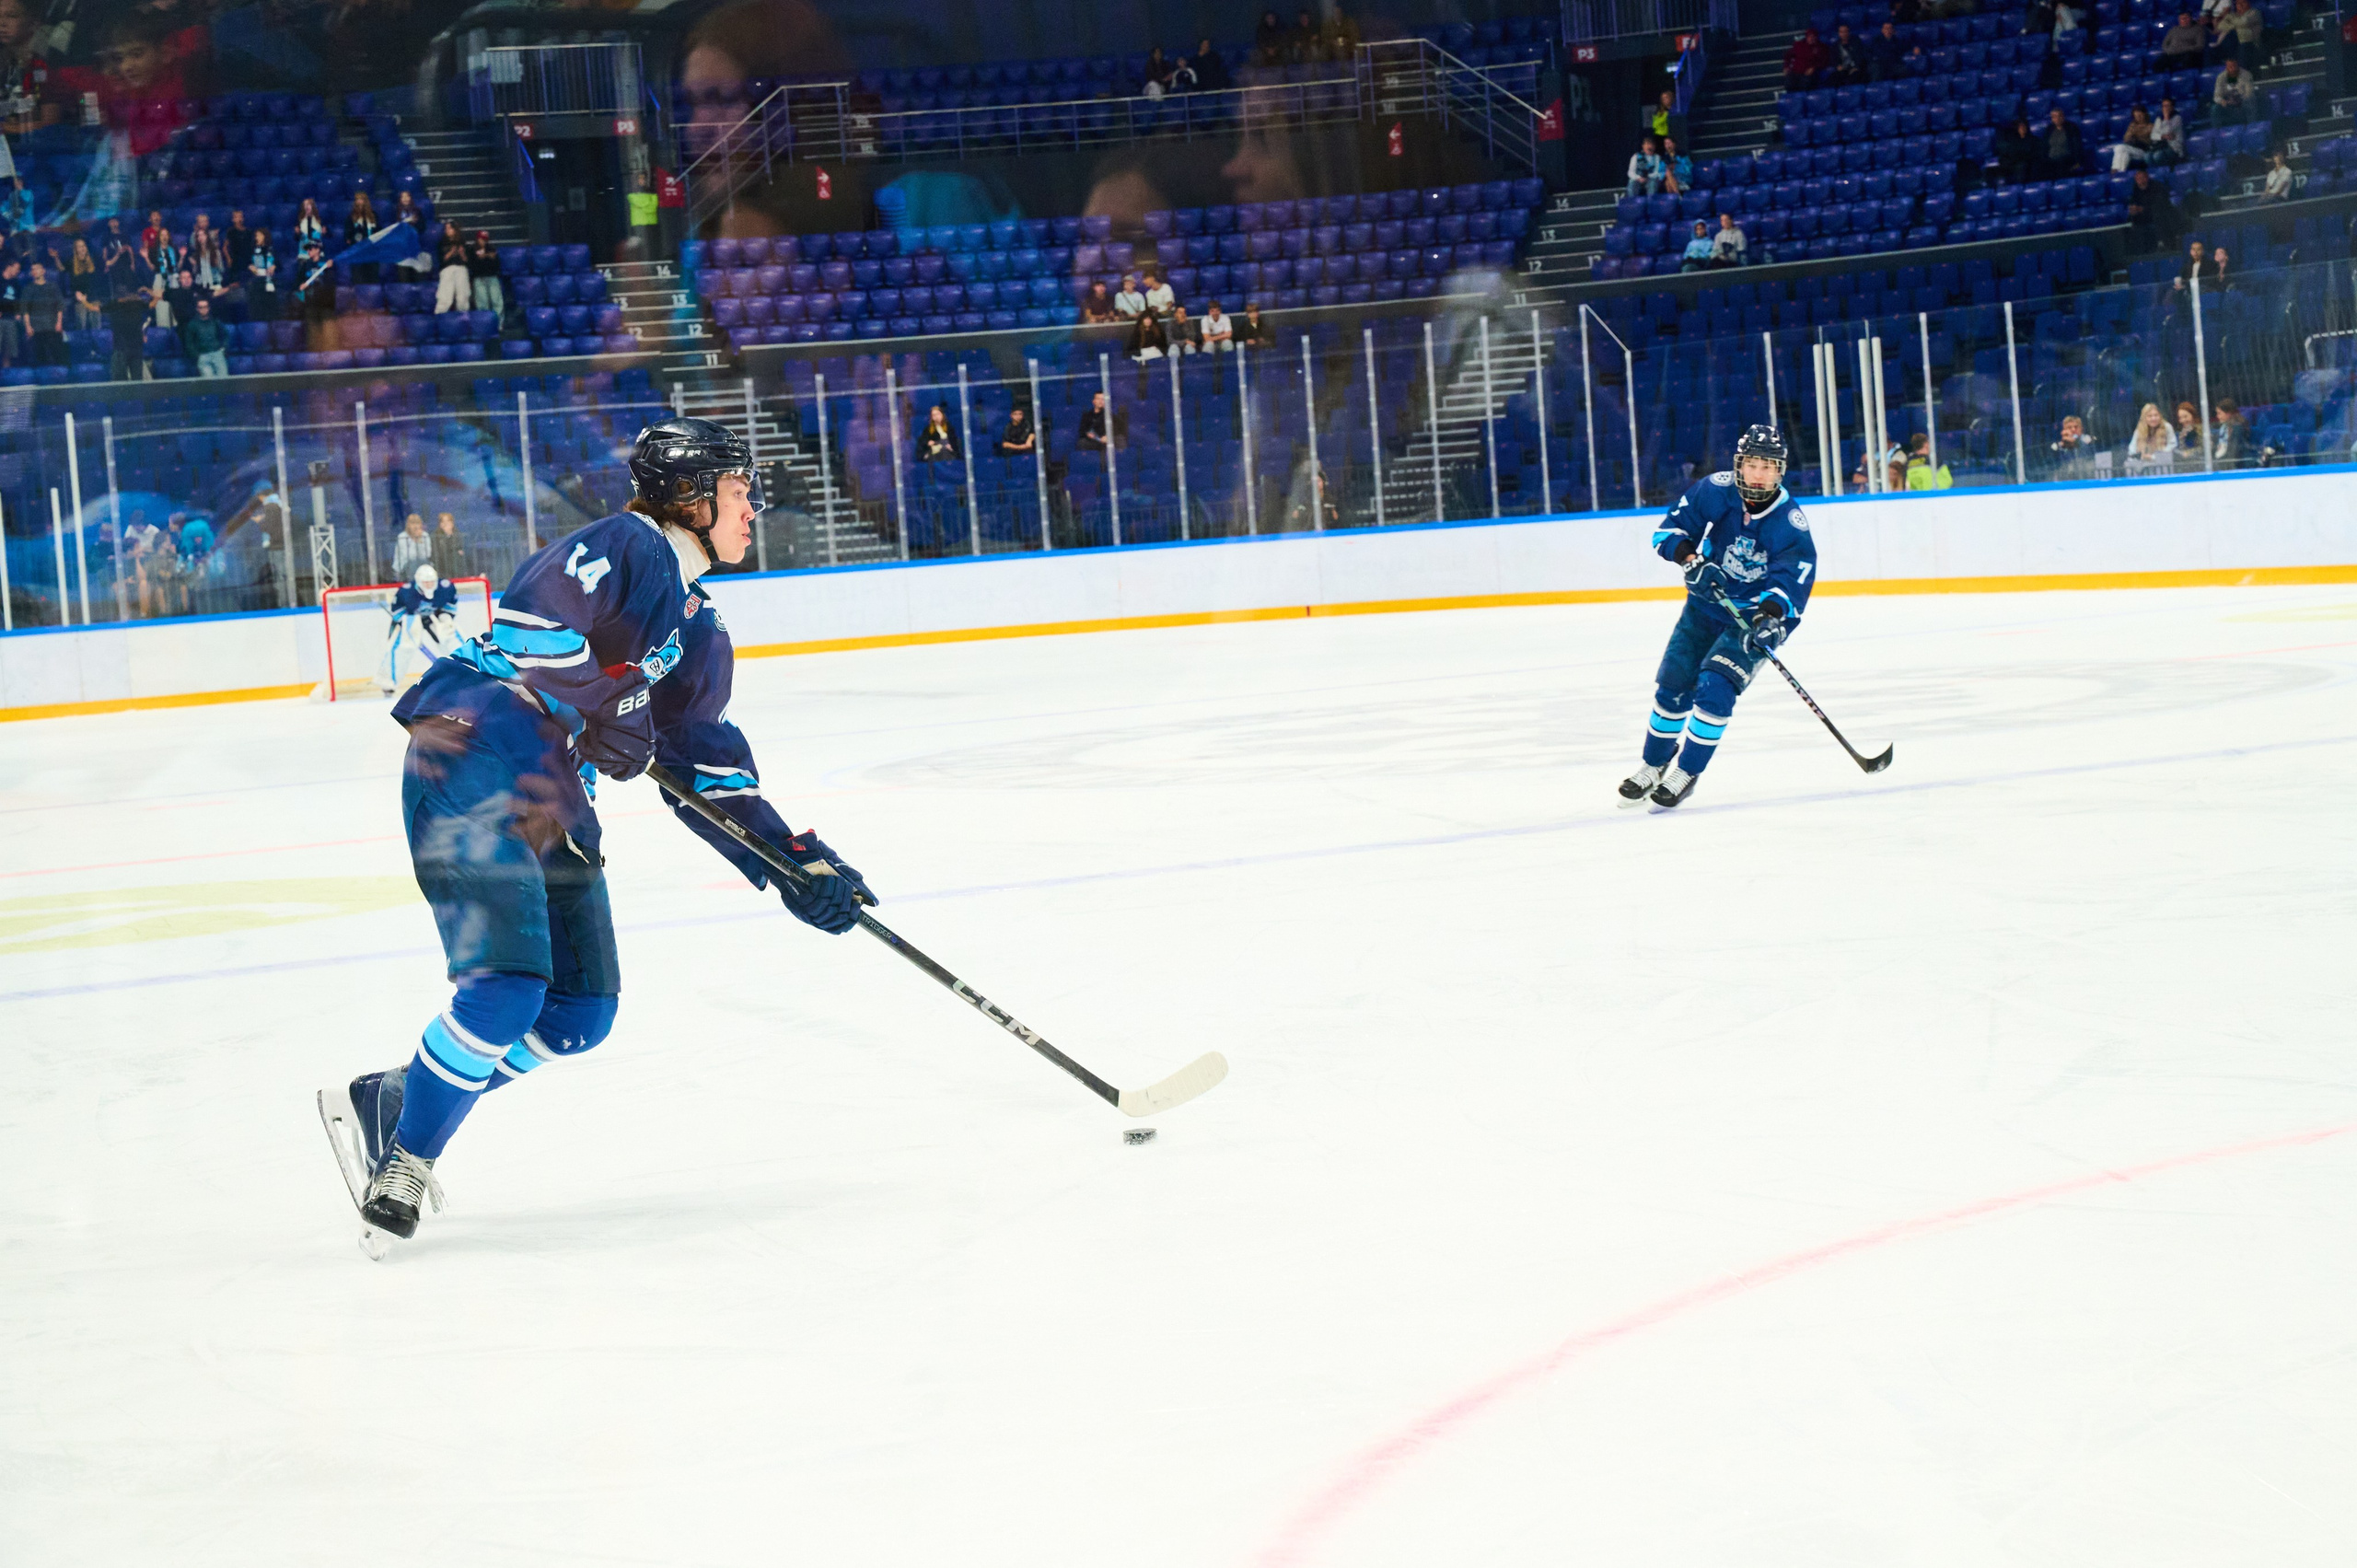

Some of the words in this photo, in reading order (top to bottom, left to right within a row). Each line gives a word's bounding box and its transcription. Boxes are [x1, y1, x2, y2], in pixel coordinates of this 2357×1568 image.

[656, 265, 671, 277] 14
[1529, 261, 1542, 273] 12
[672, 294, 687, 306] 13
[689, 324, 702, 337] 12
[705, 354, 718, 366] 11
[564, 542, 611, 594] 14
[1797, 561, 1813, 585] 7
[952, 979, 1040, 1045] CCM
